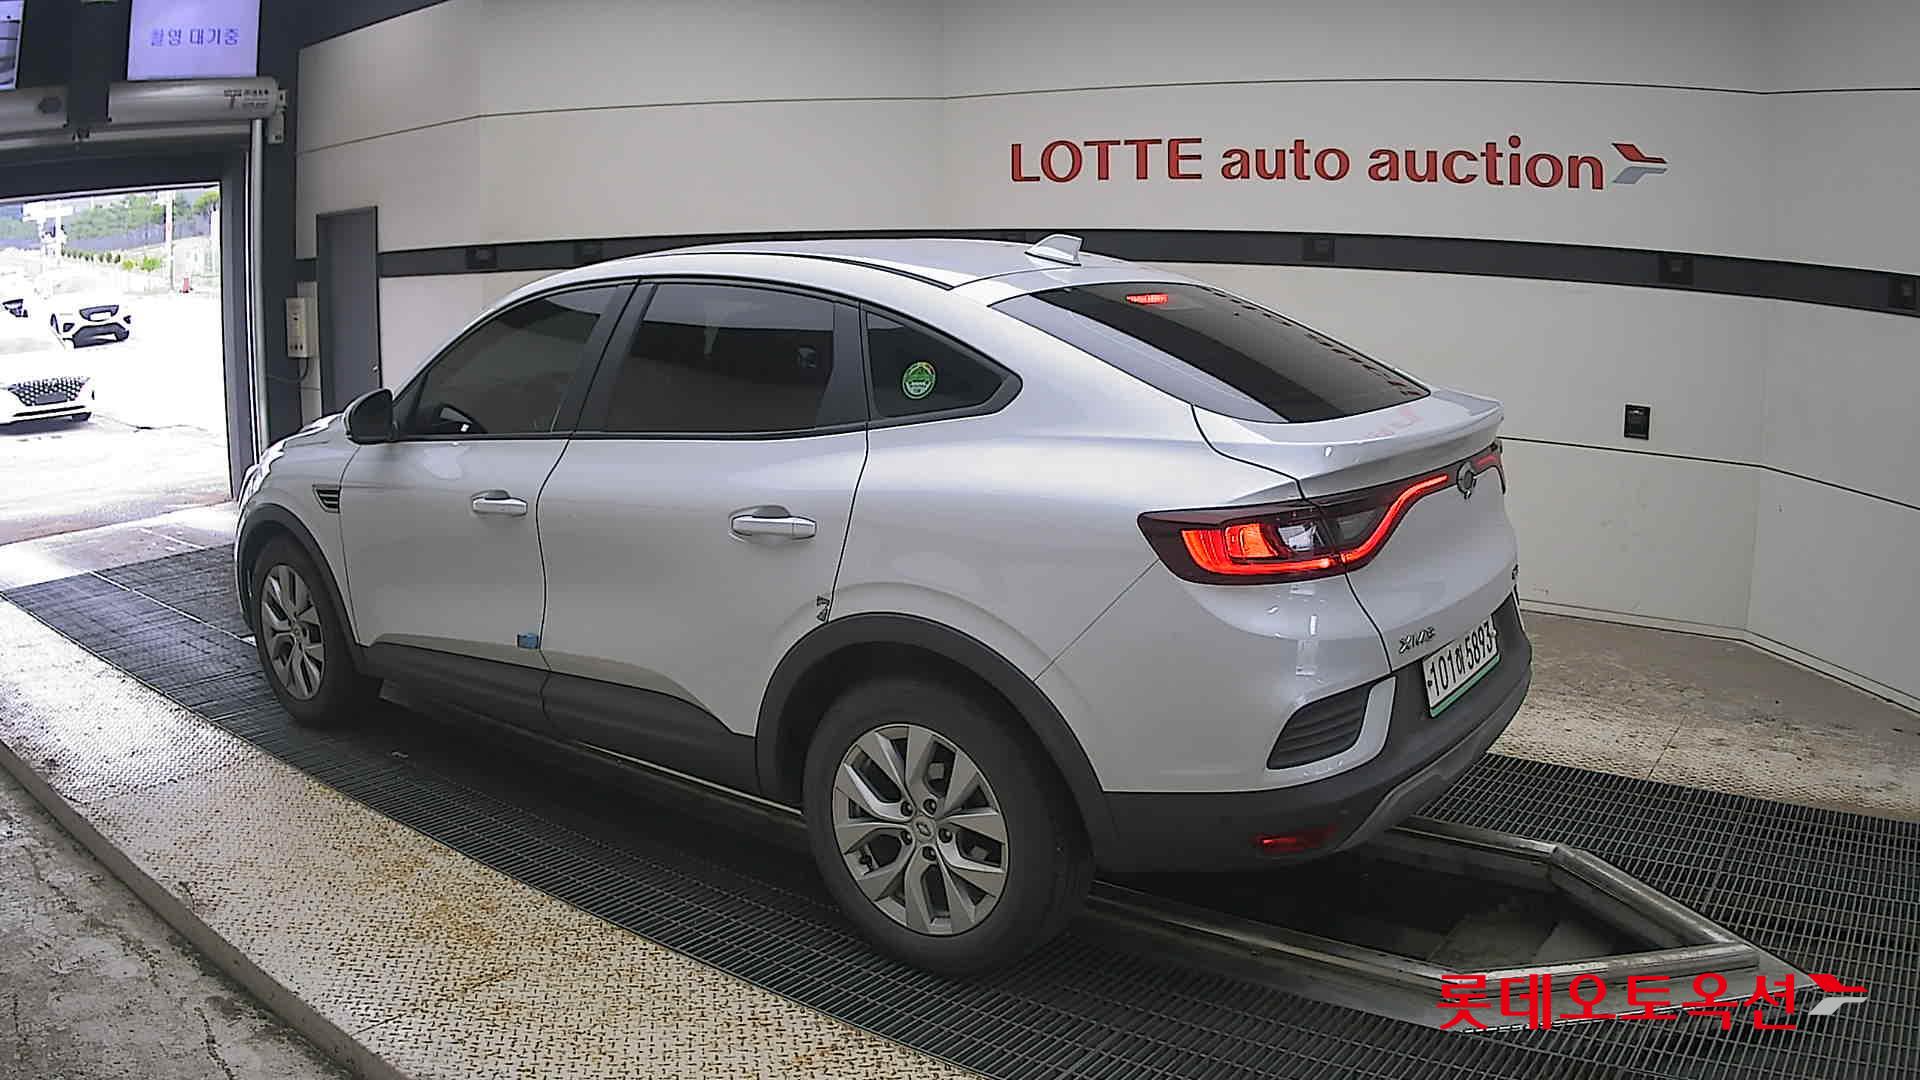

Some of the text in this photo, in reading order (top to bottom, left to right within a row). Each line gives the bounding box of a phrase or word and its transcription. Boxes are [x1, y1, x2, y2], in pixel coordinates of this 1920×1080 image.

[189, 28, 239, 46] 대기중
[1010, 135, 1605, 190] LOTTE auto auction
